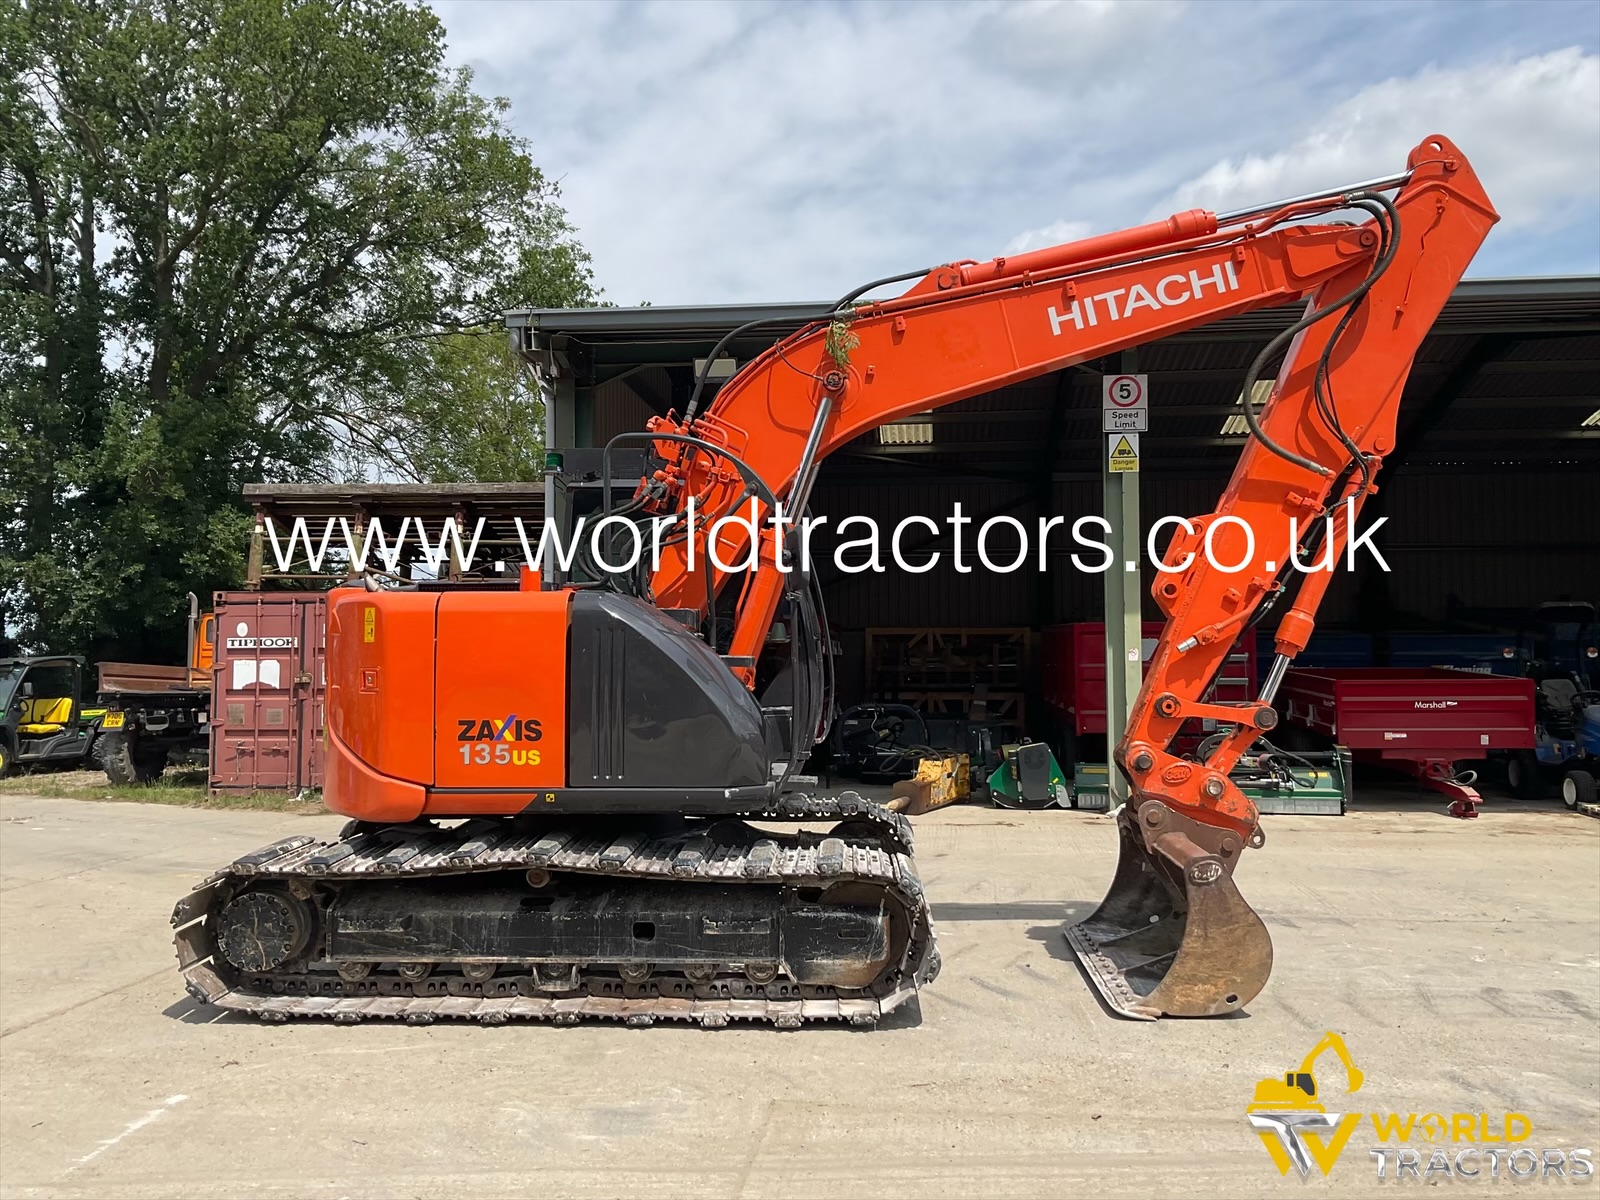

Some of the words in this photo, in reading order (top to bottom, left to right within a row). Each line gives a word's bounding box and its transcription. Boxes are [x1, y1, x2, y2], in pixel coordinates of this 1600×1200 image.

[1047, 260, 1239, 336] HITACHI
[1119, 383, 1132, 400] 5
[1112, 411, 1139, 420] Speed
[1114, 421, 1136, 429] Limit
[1414, 701, 1447, 709] Marshall
[457, 713, 542, 742] ZAXIS
